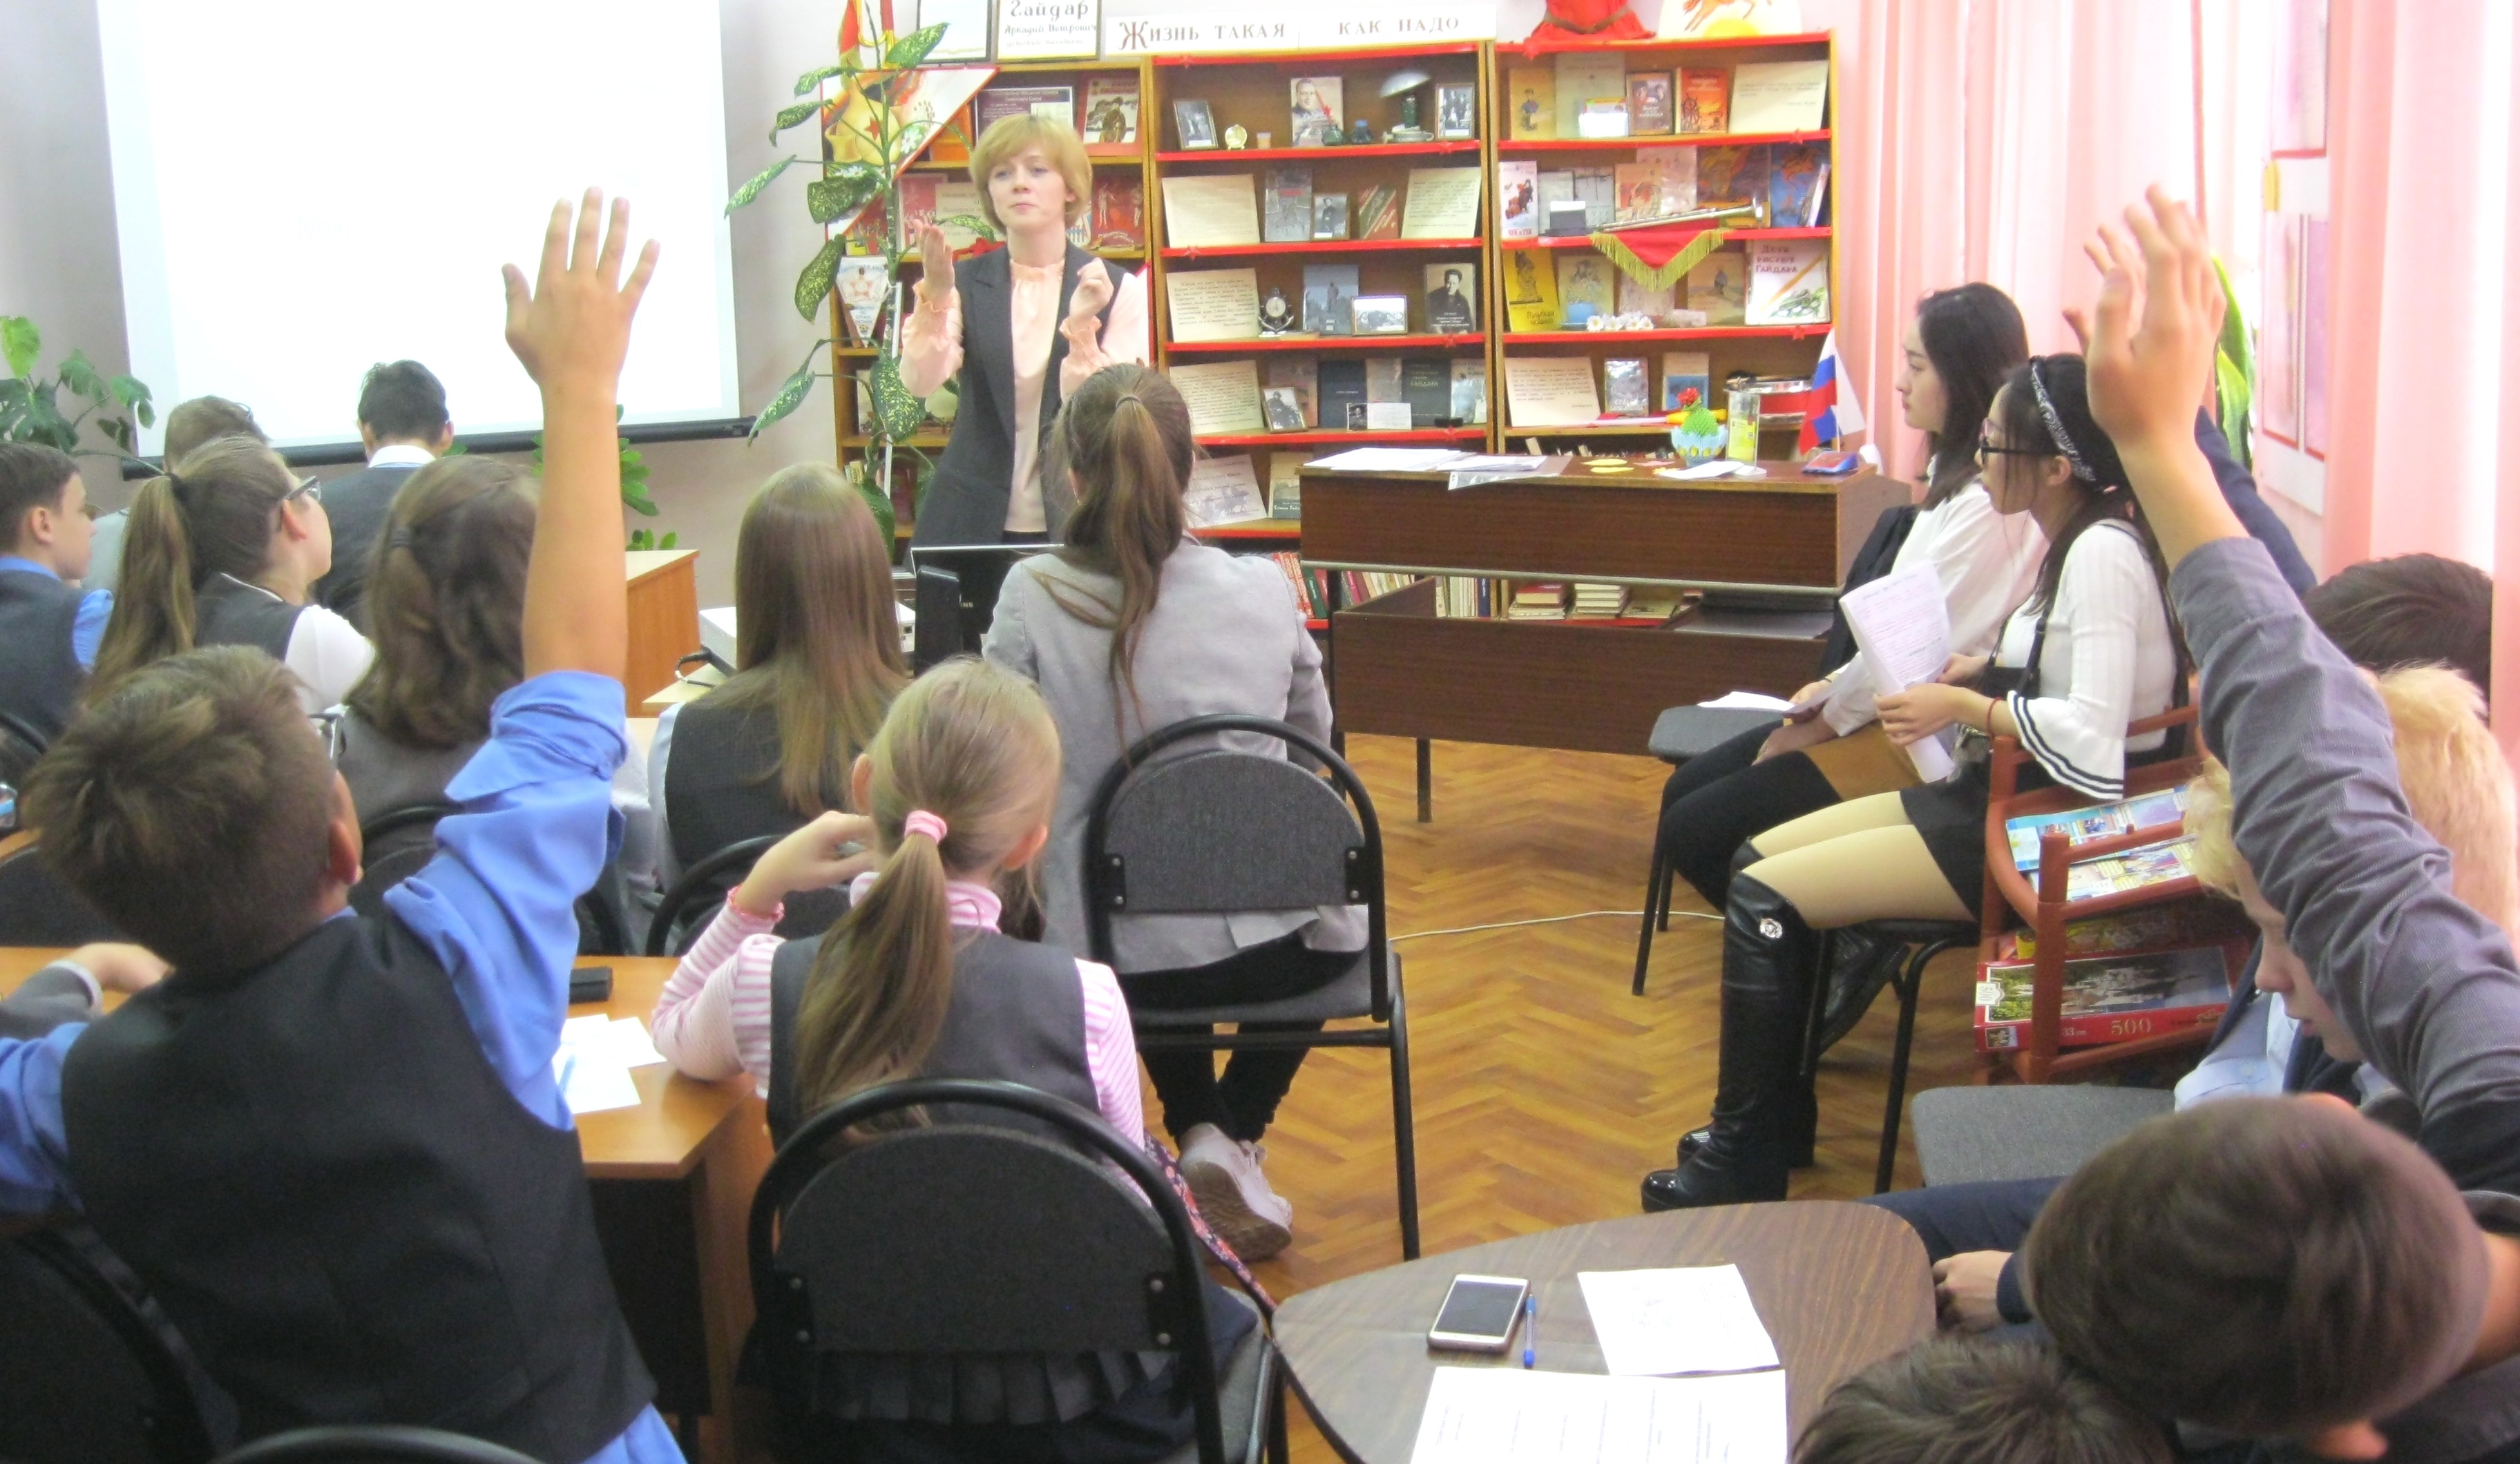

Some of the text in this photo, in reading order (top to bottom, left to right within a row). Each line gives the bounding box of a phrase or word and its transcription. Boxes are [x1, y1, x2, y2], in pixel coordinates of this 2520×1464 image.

[1011, 0, 1089, 22] Гайдар
[1004, 23, 1096, 37] Аркадий Петрович
[1214, 23, 1285, 39] ТАКАЯ
[1339, 20, 1382, 35] КАК
[1398, 17, 1460, 32] НАДО
[1978, 985, 1994, 1001] 500
[2111, 1017, 2152, 1036] 500
